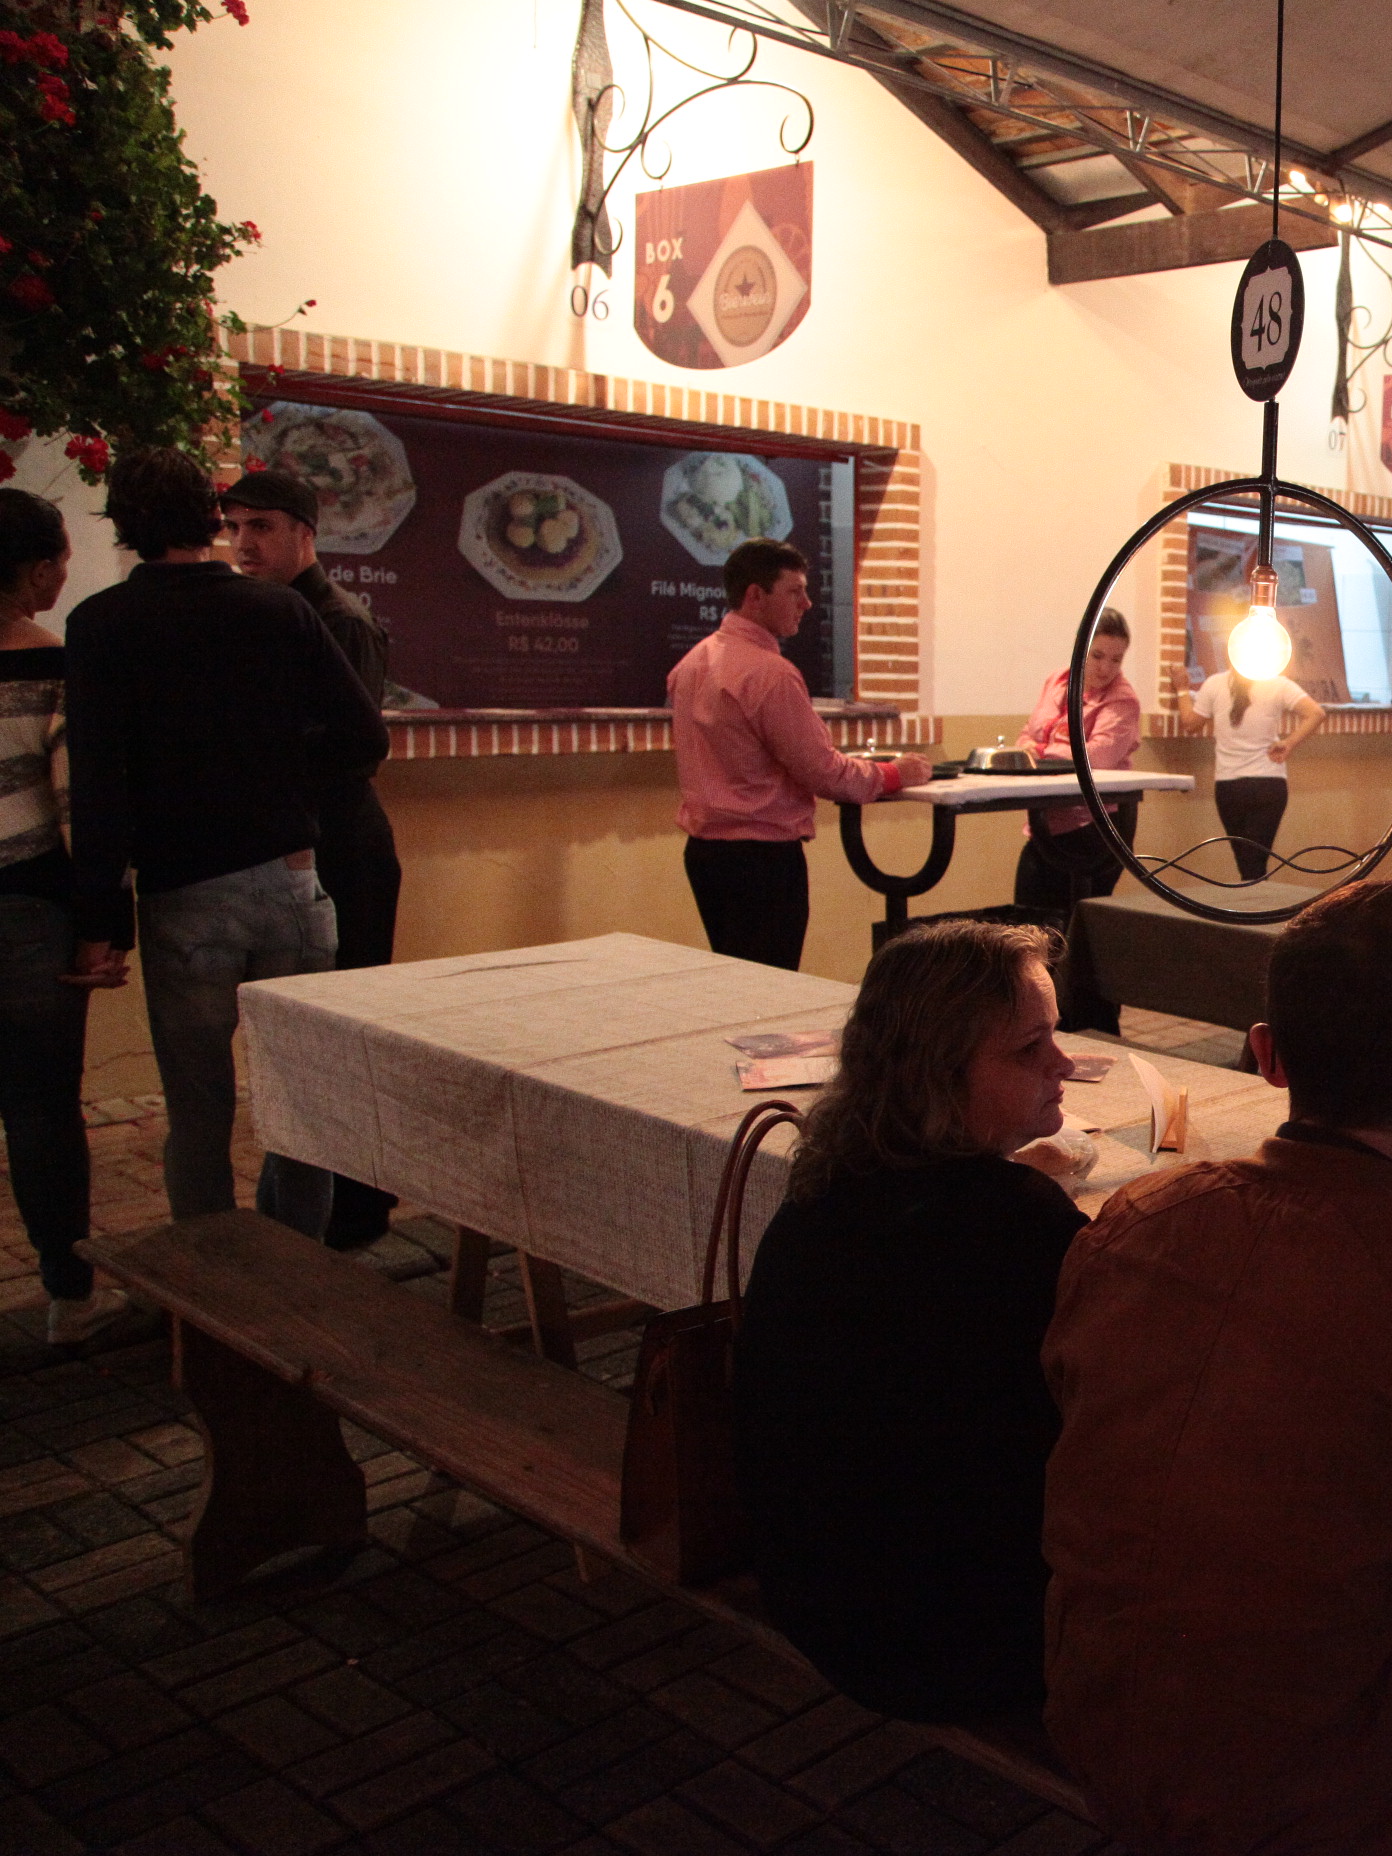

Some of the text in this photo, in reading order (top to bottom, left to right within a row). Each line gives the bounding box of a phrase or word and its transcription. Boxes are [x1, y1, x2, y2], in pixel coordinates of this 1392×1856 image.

[645, 237, 684, 265] BOX
[571, 285, 609, 321] 06
[652, 273, 675, 324] 6
[1250, 291, 1282, 353] 48
[329, 565, 398, 585] de Brie
[508, 635, 530, 652] R$
